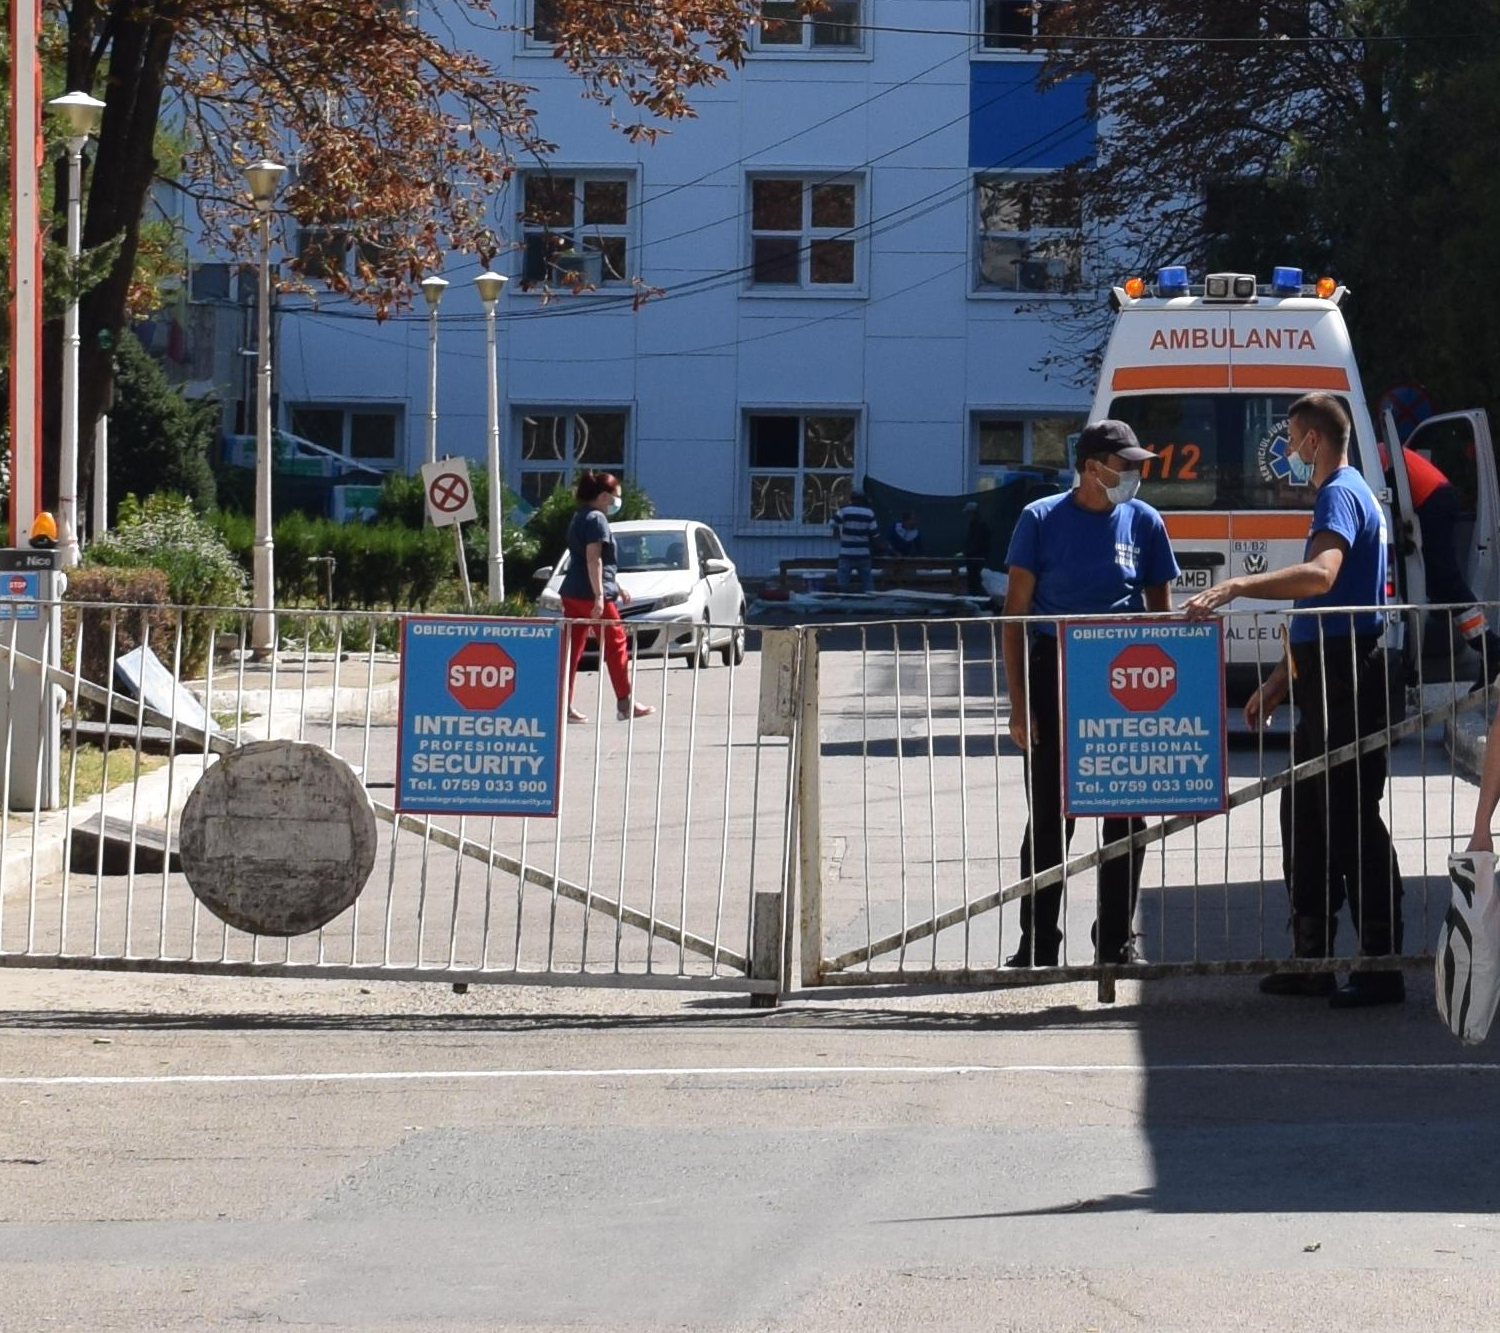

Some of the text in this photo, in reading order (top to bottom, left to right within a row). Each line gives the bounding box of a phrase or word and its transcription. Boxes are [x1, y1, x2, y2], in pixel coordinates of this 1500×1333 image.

[1149, 328, 1317, 350] AMBULANTA
[1258, 437, 1273, 482] SERVICIUL
[413, 624, 554, 638] OBIECTIV PROTEJAT
[1073, 626, 1212, 640] OBIECTIV PROTEJAT
[450, 665, 515, 687] STOP
[1111, 666, 1176, 689] STOP
[413, 715, 546, 737] INTEGRAL
[1078, 717, 1210, 738] INTEGRAL
[420, 740, 538, 753] PROFESIONAL
[1085, 741, 1202, 753] PROFESIONAL
[411, 753, 545, 775] SECURITY
[1078, 754, 1210, 776] SECURITY
[409, 778, 547, 793] Tel. 0759 033 900
[1076, 778, 1214, 793] Tel. 0759 033 900
